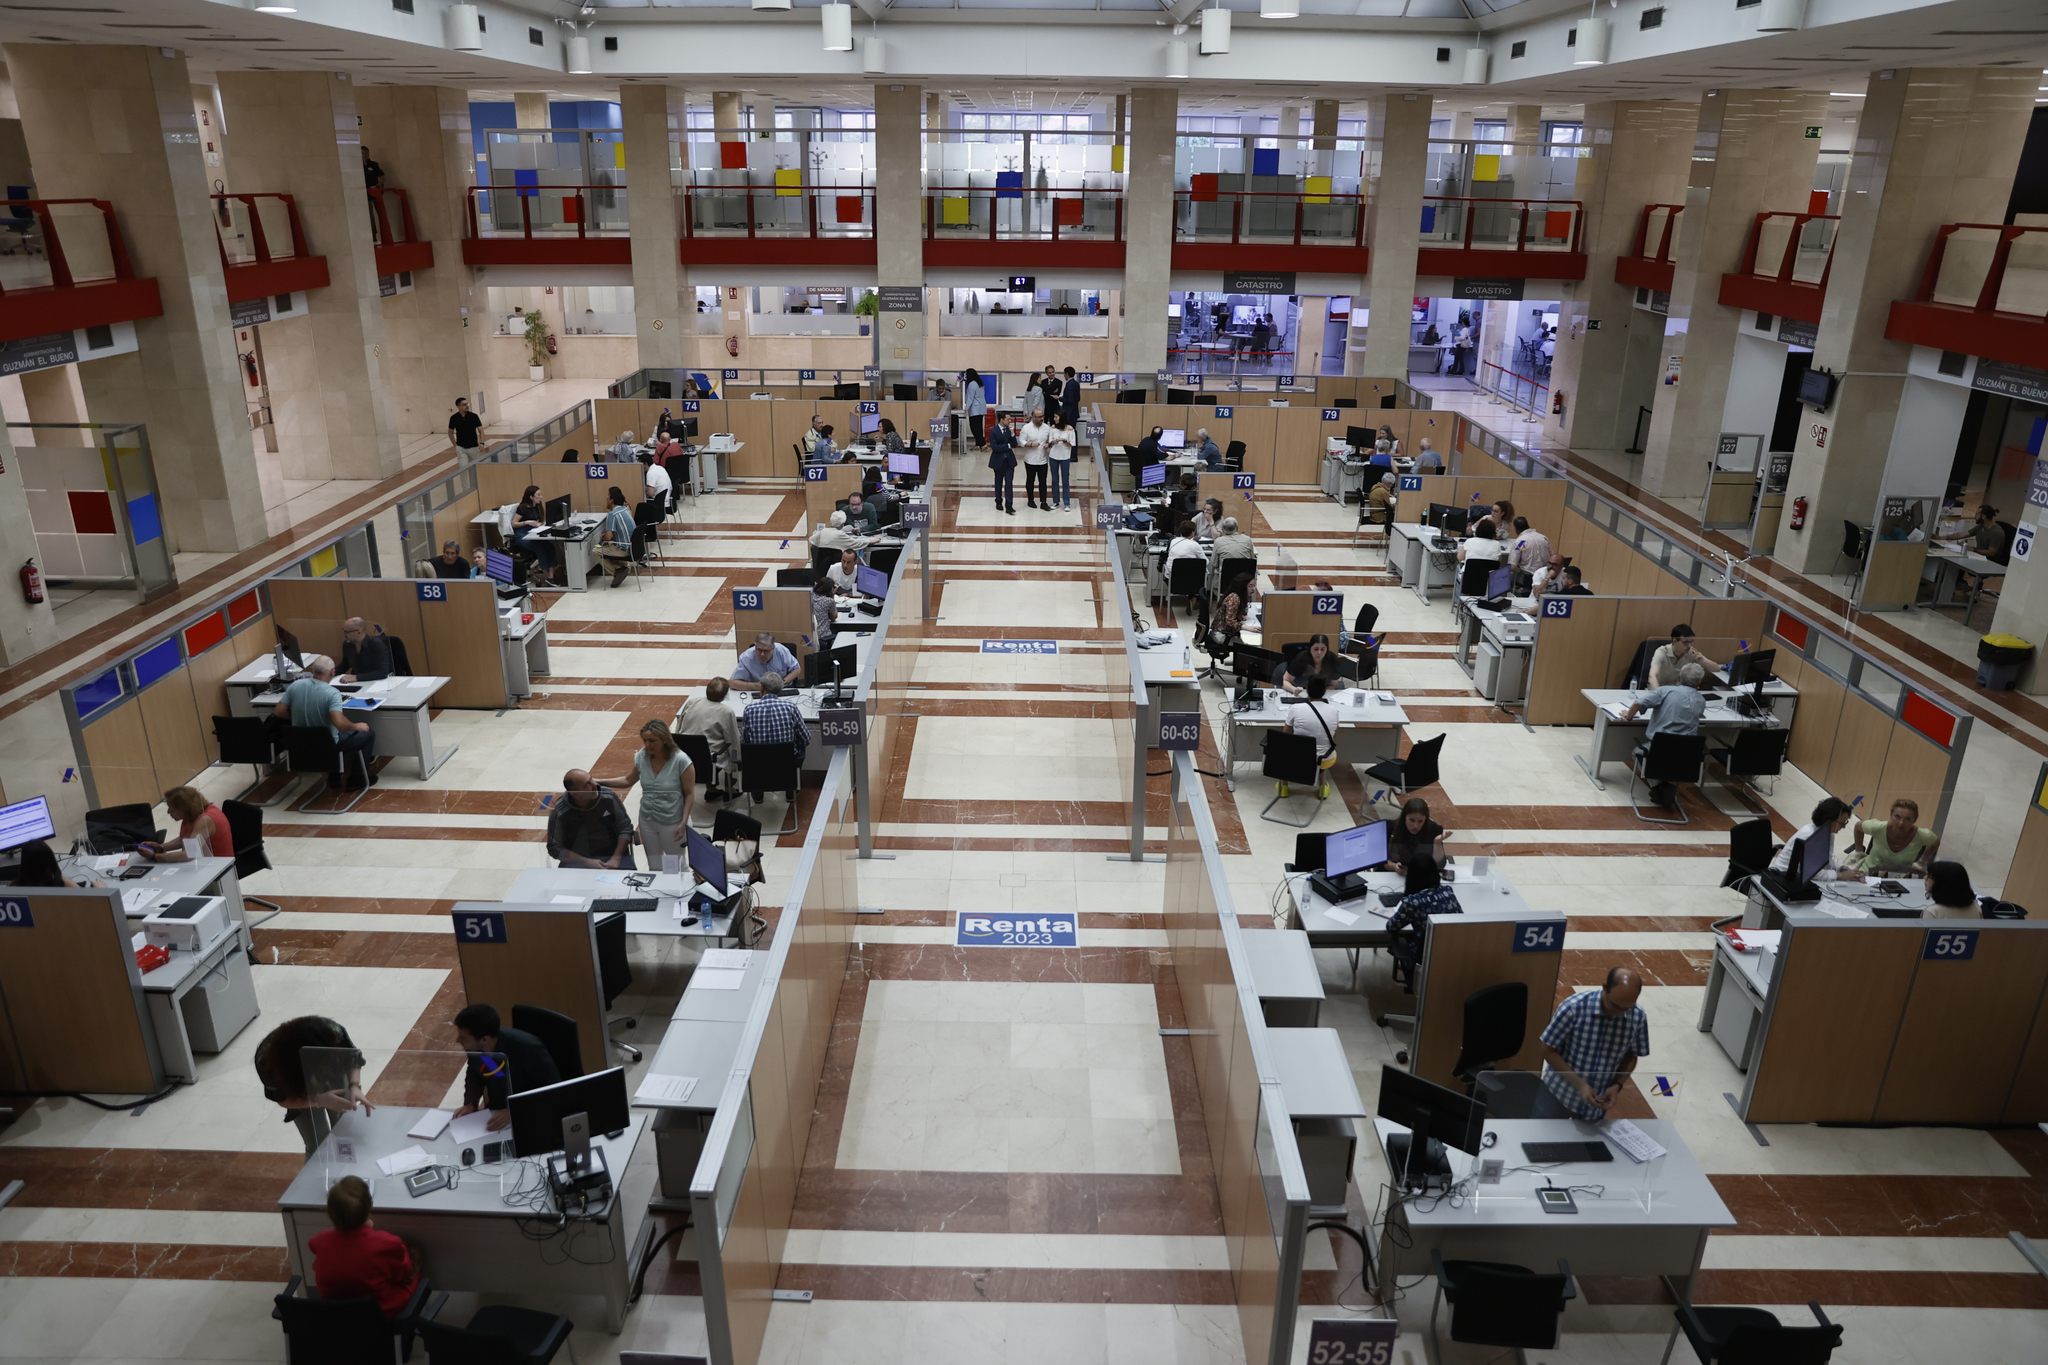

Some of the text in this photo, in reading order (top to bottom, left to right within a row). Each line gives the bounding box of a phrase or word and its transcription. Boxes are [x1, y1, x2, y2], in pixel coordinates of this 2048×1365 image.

[1236, 281, 1283, 289] CATASTRO
[2, 351, 74, 372] GUZMÁN EL BUENO
[725, 370, 736, 379] 80
[803, 370, 812, 379] 81
[864, 370, 880, 378] 80-82
[1080, 374, 1092, 382] 83
[1157, 373, 1173, 382] 83-85
[1189, 376, 1200, 384] 84
[1280, 377, 1292, 385] 85
[1976, 377, 2048, 399] GUZMÁN EL BUENO
[685, 402, 698, 411] 74
[863, 403, 876, 412] 75
[1218, 408, 1230, 417] 78
[1325, 410, 1338, 420] 79
[930, 423, 949, 433] 72-75
[1087, 426, 1105, 435] 76-79
[1720, 444, 1736, 453] 127
[590, 466, 605, 477] 66
[808, 468, 824, 480] 67
[1771, 464, 1788, 474] 126
[1236, 476, 1252, 487] 70
[1404, 478, 1418, 489] 71
[904, 511, 929, 522] 64-67
[1884, 506, 1904, 517] 125
[1097, 512, 1121, 524] 68-71
[423, 585, 442, 599] 58
[739, 593, 758, 607] 59
[1317, 597, 1338, 612] 62
[1547, 600, 1568, 616] 63
[985, 641, 1056, 649] Renta
[822, 720, 859, 736] 56-59
[1161, 725, 1198, 741] 60-63
[465, 917, 495, 938] 51
[964, 917, 1073, 934] Renta
[1002, 932, 1053, 945] 2023
[1523, 926, 1554, 947] 54
[1934, 934, 1968, 955] 55
[1312, 1340, 1389, 1365] 52-55
